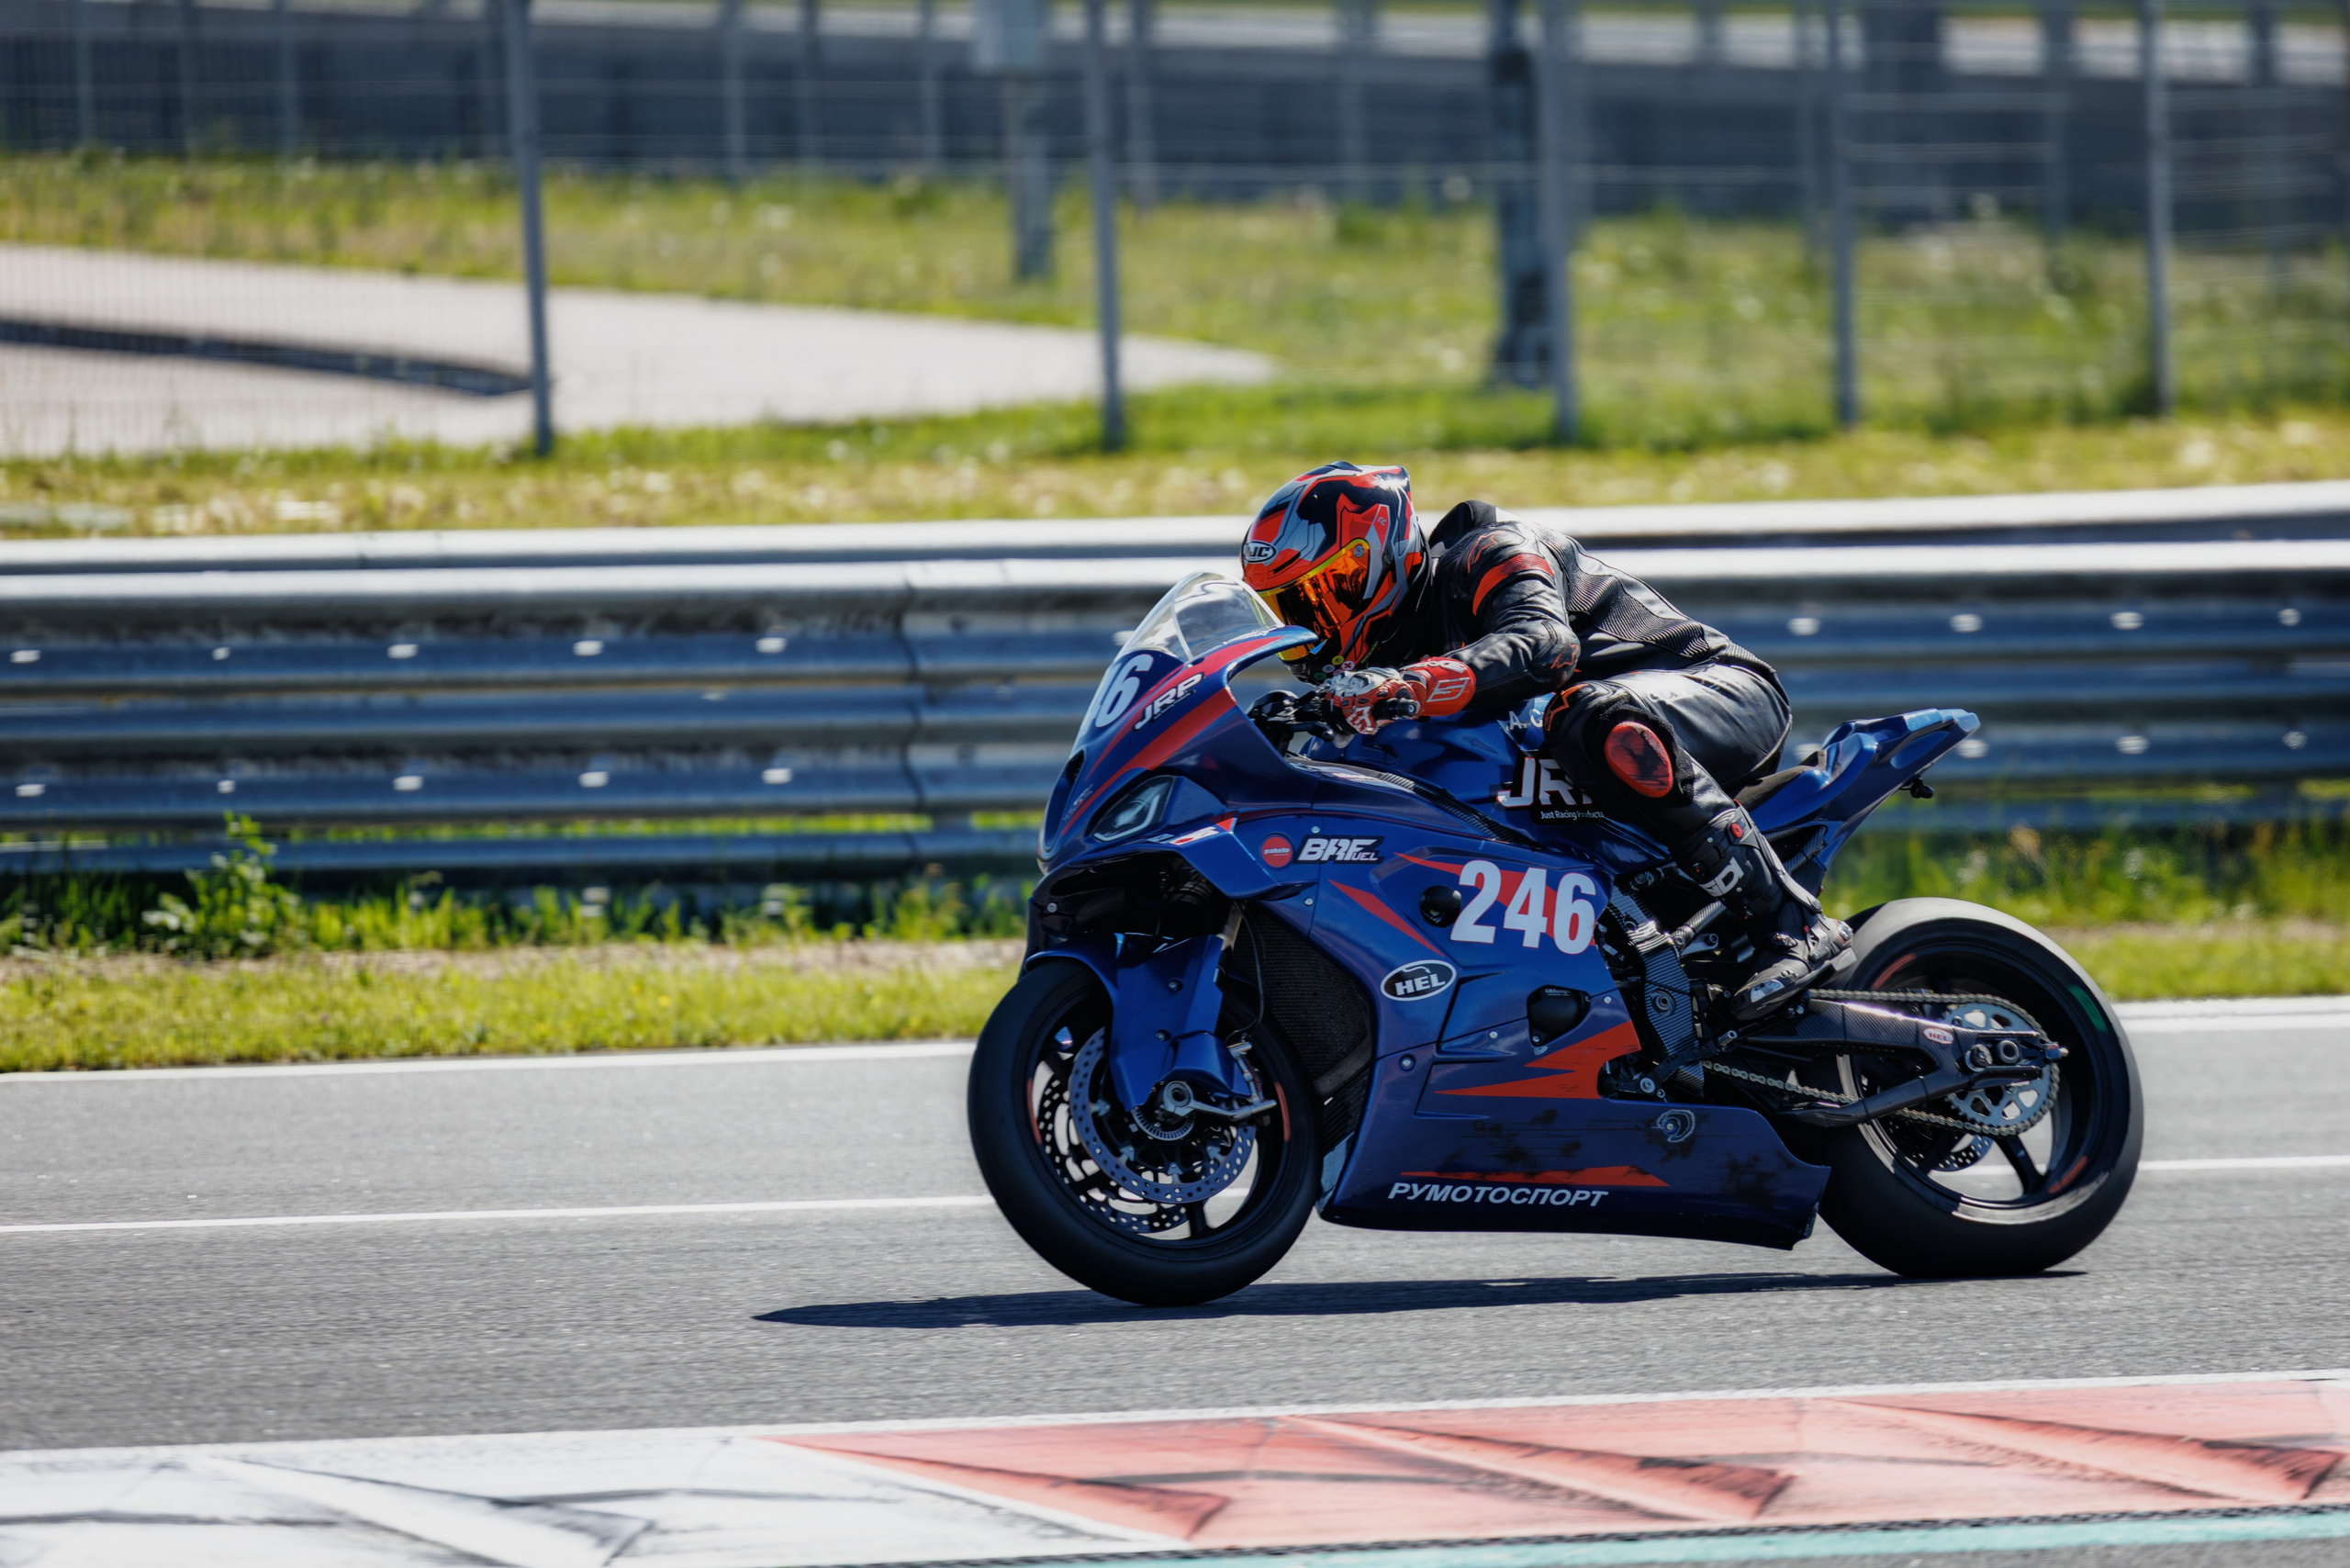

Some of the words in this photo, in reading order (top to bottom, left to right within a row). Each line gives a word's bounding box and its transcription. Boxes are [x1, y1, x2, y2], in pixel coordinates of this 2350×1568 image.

[1134, 673, 1203, 730] JRP
[1496, 756, 1594, 808] JR
[1540, 810, 1555, 819] Just
[1555, 810, 1577, 821] Racing
[1450, 859, 1597, 955] 246
[1394, 973, 1446, 996] HEL
[1929, 1032, 1951, 1042] HEL
[1387, 1182, 1609, 1207] РУМОТОСПОРТ
